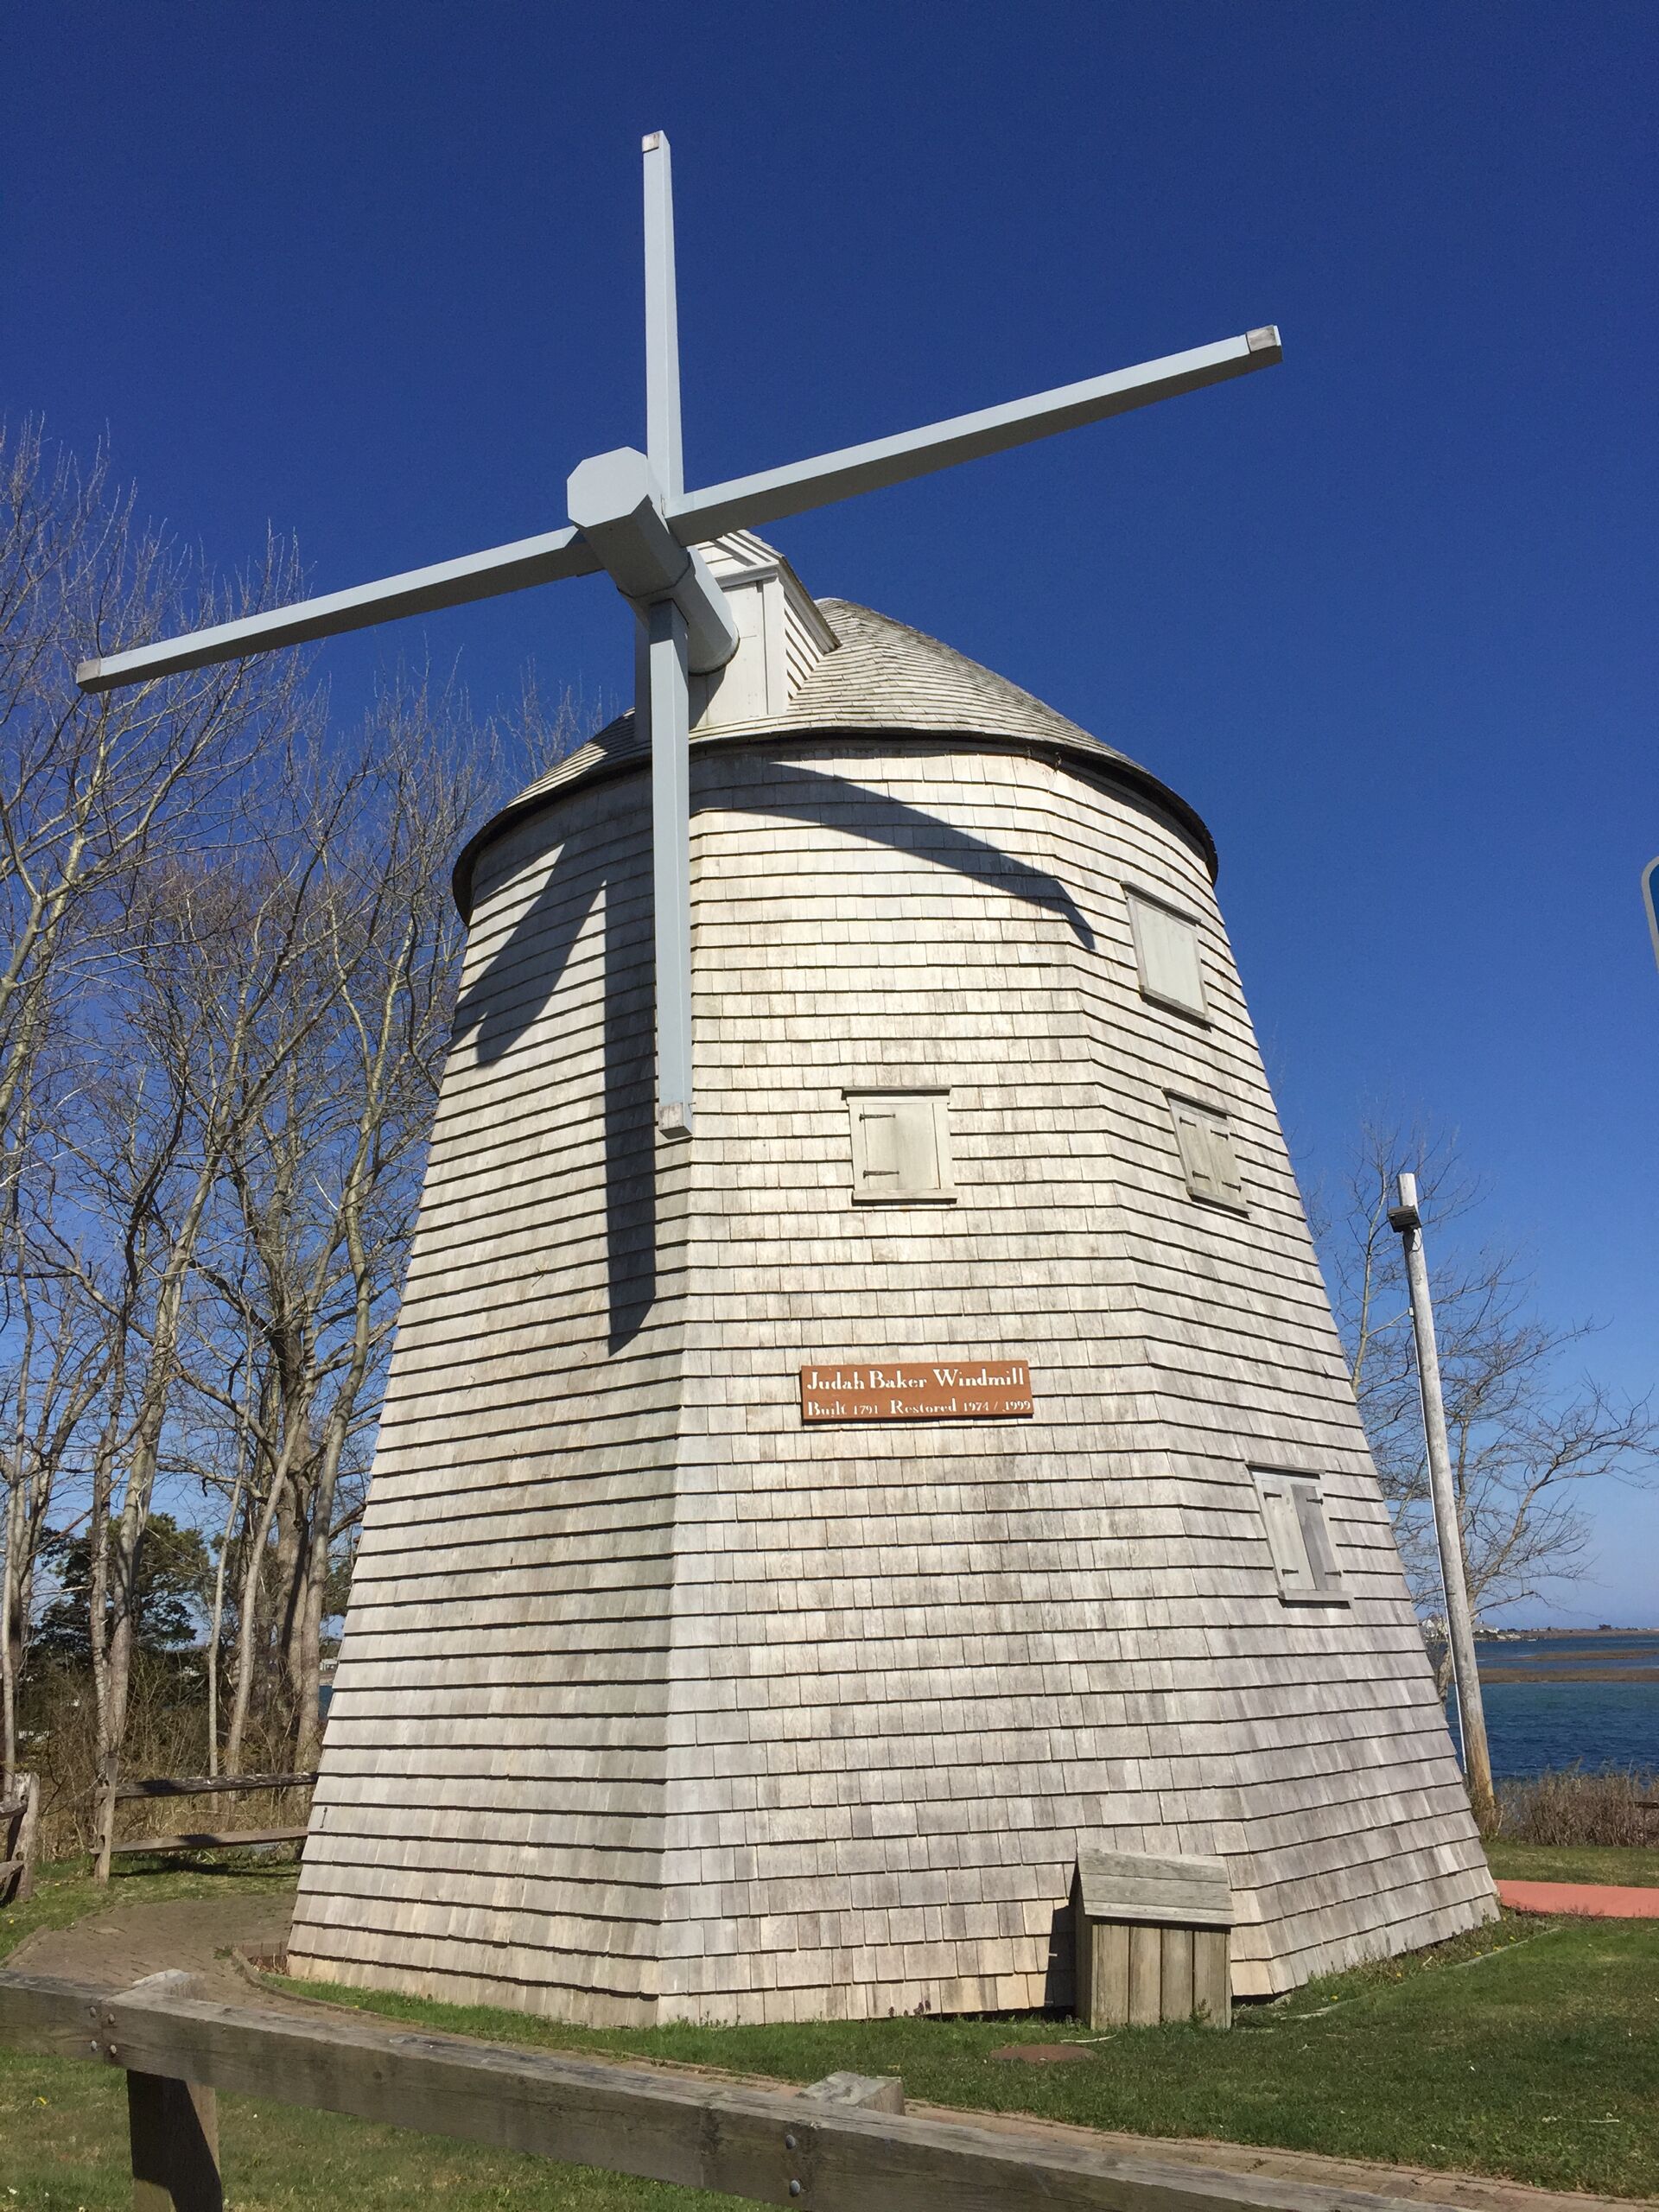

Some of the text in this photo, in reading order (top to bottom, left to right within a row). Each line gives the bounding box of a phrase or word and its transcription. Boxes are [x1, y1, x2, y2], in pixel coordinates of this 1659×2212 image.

[807, 1367, 1024, 1389] Judah Baker Windmill
[808, 1401, 847, 1416] Built
[854, 1405, 879, 1415] 1791
[890, 1398, 957, 1414] Restored
[963, 1402, 988, 1412] 1974
[1003, 1400, 1031, 1411] 1999
